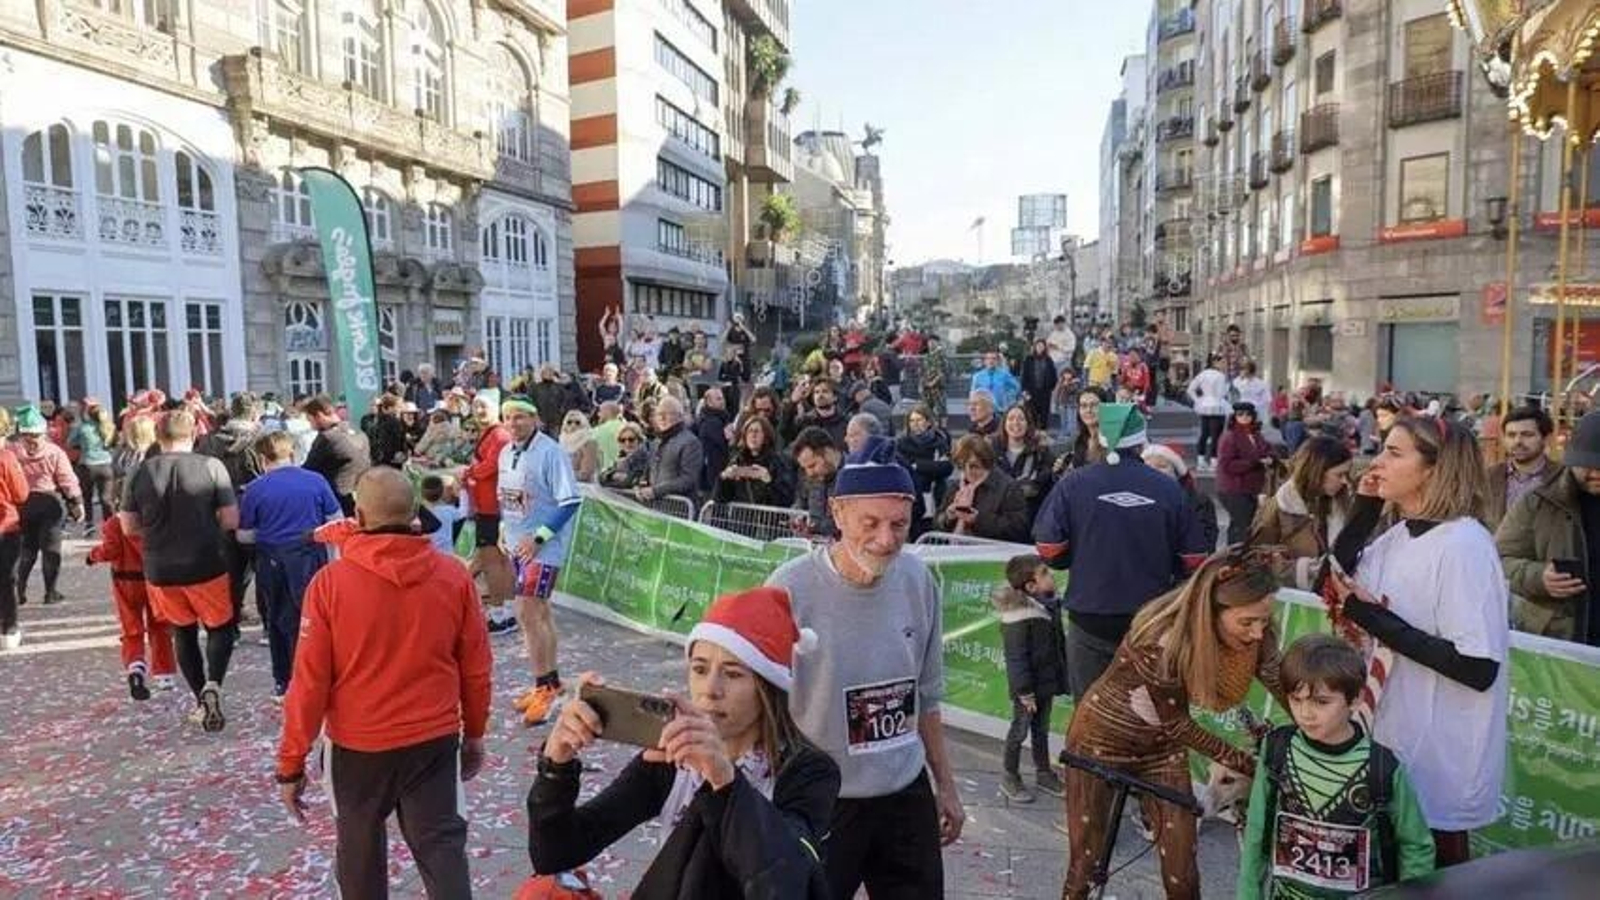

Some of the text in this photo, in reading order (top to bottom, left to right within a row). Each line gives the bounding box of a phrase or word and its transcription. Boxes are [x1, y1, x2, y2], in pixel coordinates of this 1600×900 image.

[868, 710, 908, 739] 102
[1558, 707, 1600, 746] au
[1290, 845, 1351, 879] 2413
